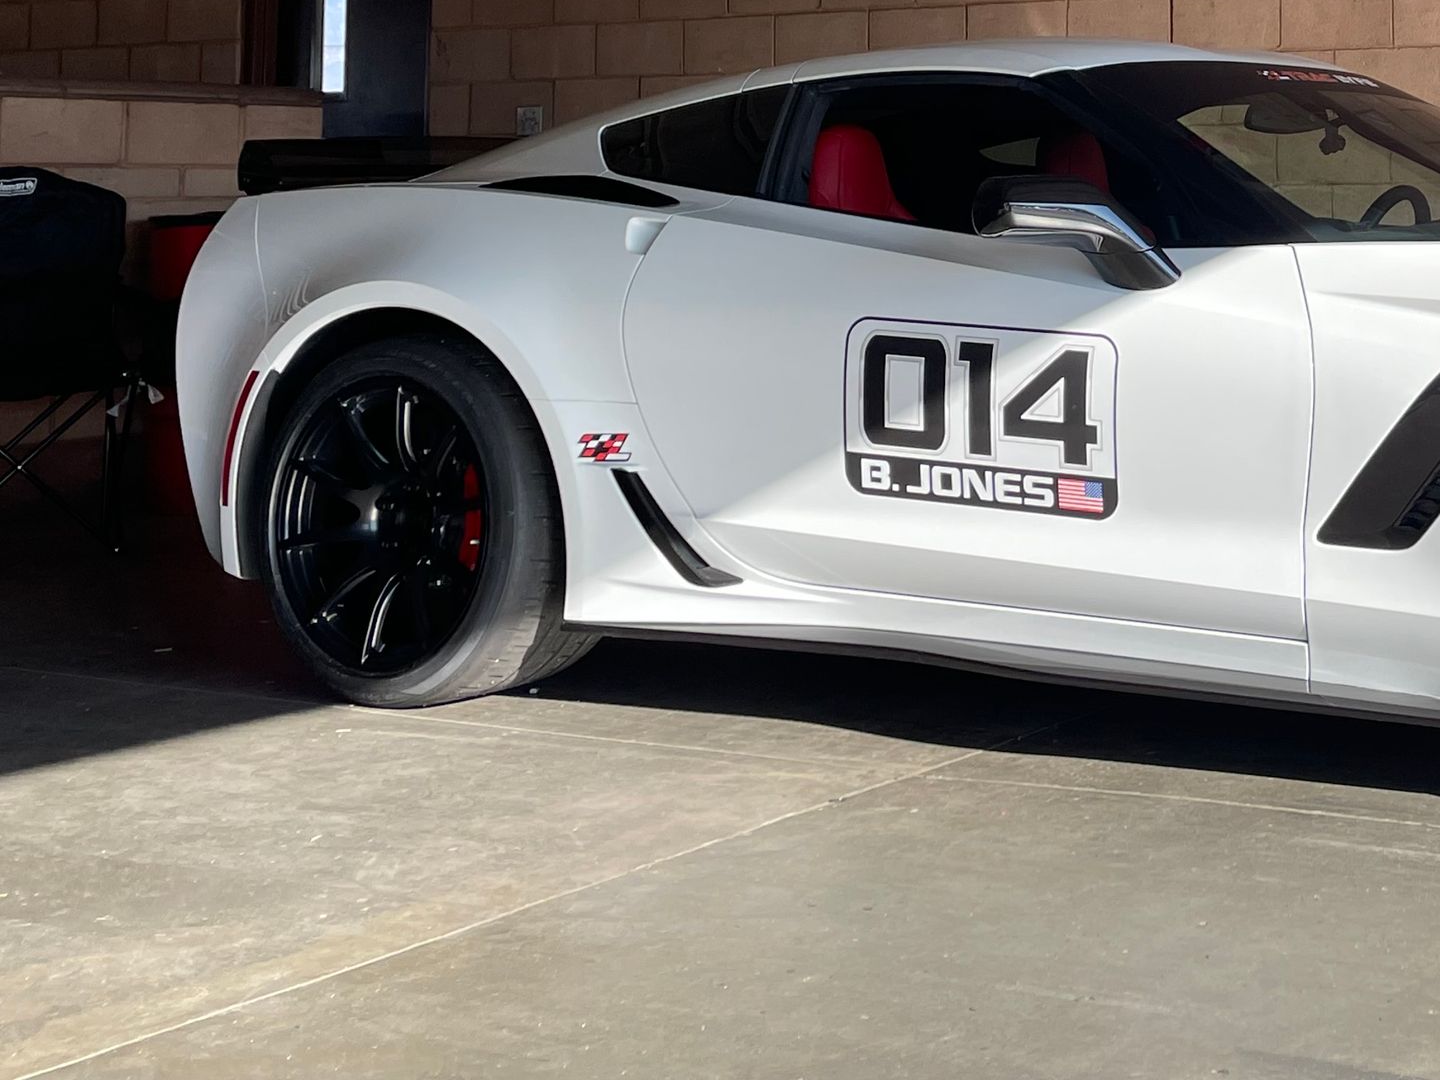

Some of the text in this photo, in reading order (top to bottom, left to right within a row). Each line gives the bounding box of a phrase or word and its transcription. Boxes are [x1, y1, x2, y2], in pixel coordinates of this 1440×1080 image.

[862, 333, 1099, 467] 014
[860, 457, 1055, 508] B. JONES
